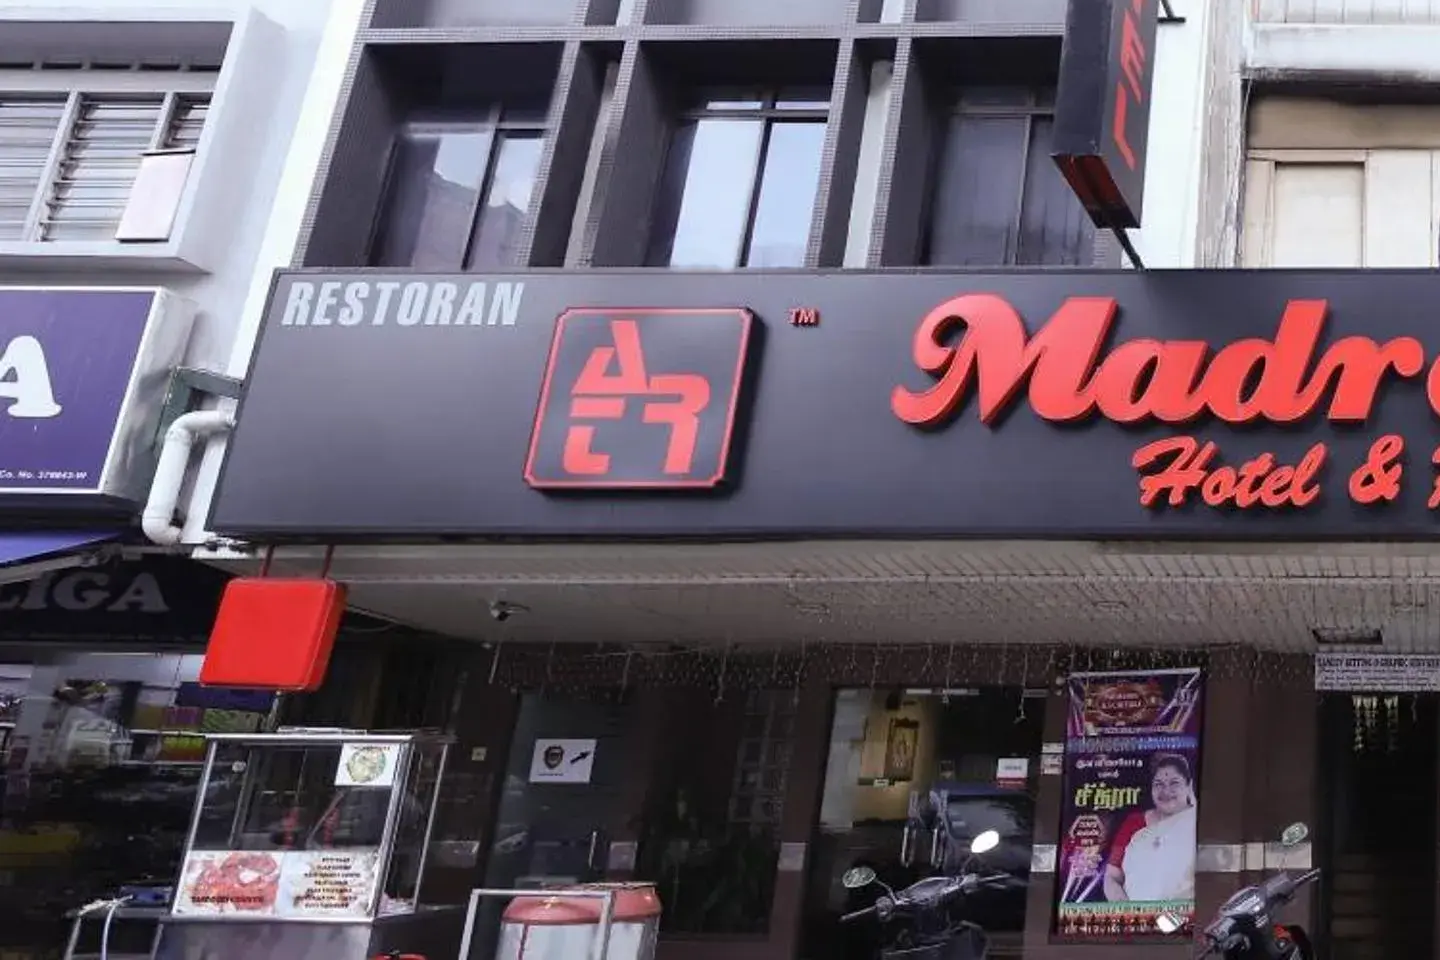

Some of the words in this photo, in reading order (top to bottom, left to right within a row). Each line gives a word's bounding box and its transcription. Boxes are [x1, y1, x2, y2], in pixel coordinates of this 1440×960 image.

[281, 281, 524, 327] RESTORAN
[1132, 436, 1327, 509] Hotel
[1349, 434, 1405, 504] &
